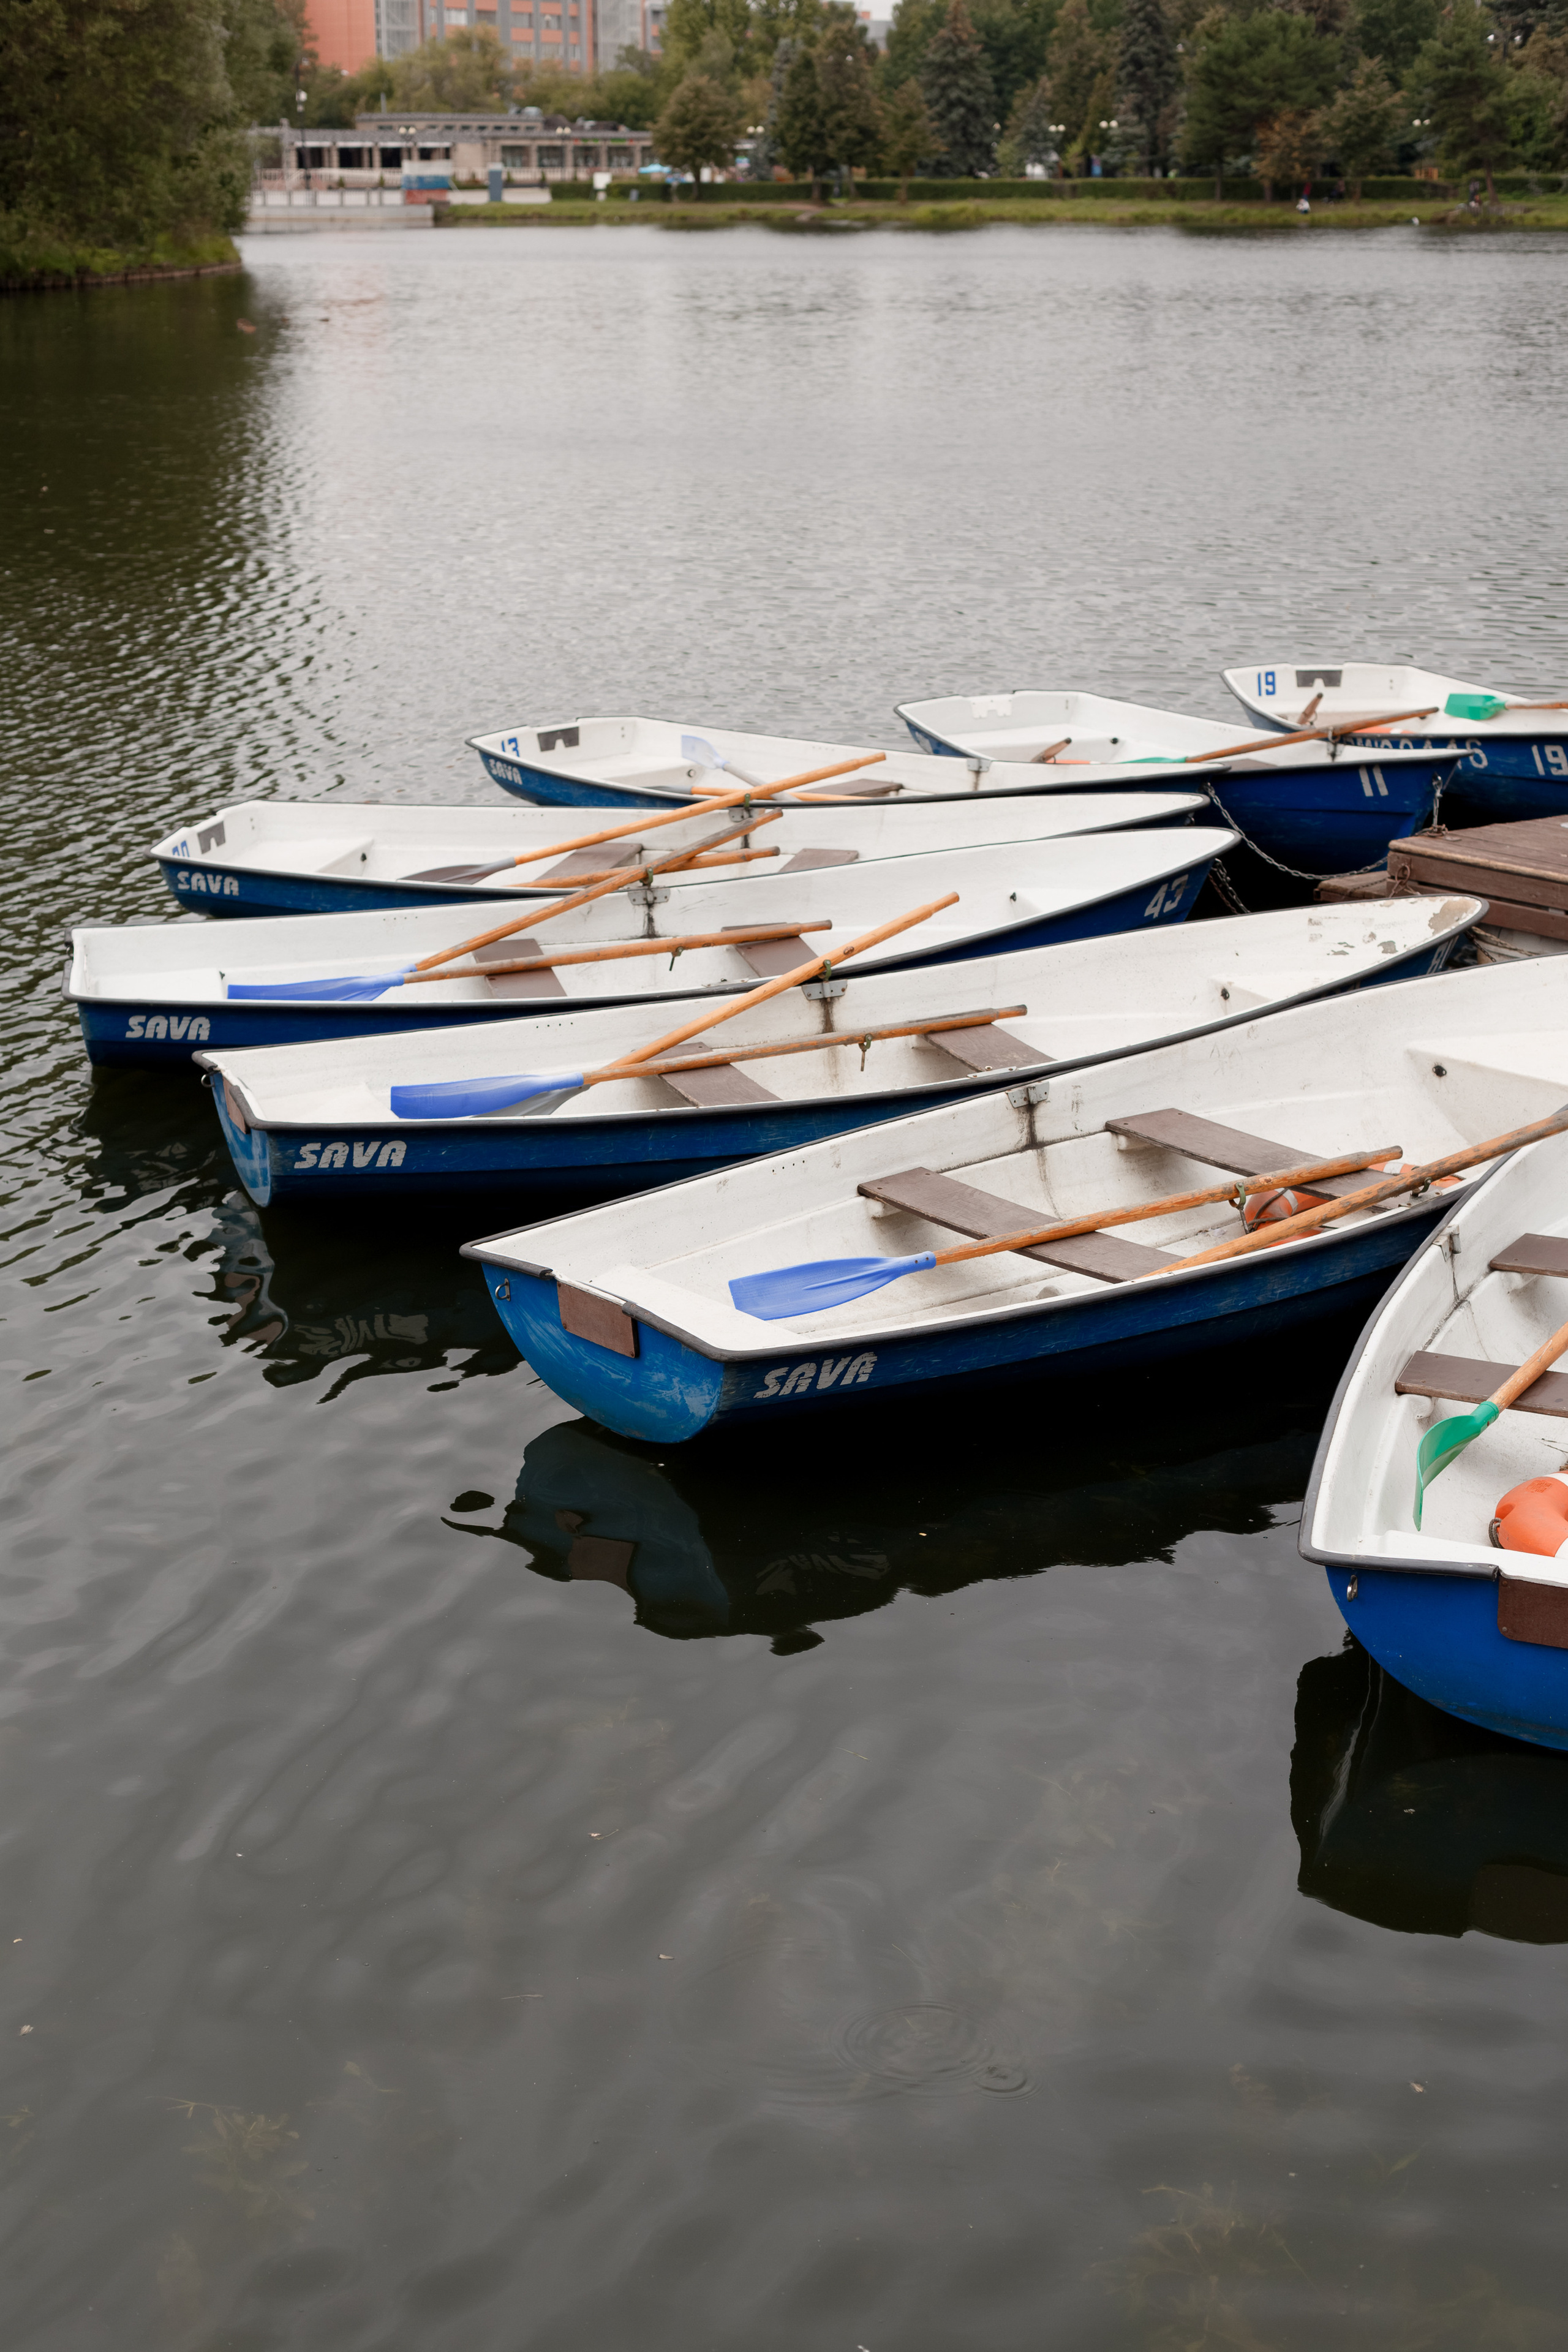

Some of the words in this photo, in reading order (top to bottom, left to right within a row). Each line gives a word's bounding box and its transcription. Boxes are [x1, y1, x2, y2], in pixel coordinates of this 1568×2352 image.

[1257, 671, 1276, 696] 19
[489, 758, 523, 786] SAVA
[1531, 744, 1568, 775] 19
[177, 871, 239, 896] SAVA
[1144, 873, 1189, 919] 43
[125, 1015, 211, 1041] SAVA
[294, 1140, 407, 1169] SAVA
[753, 1351, 878, 1399] SAVA
